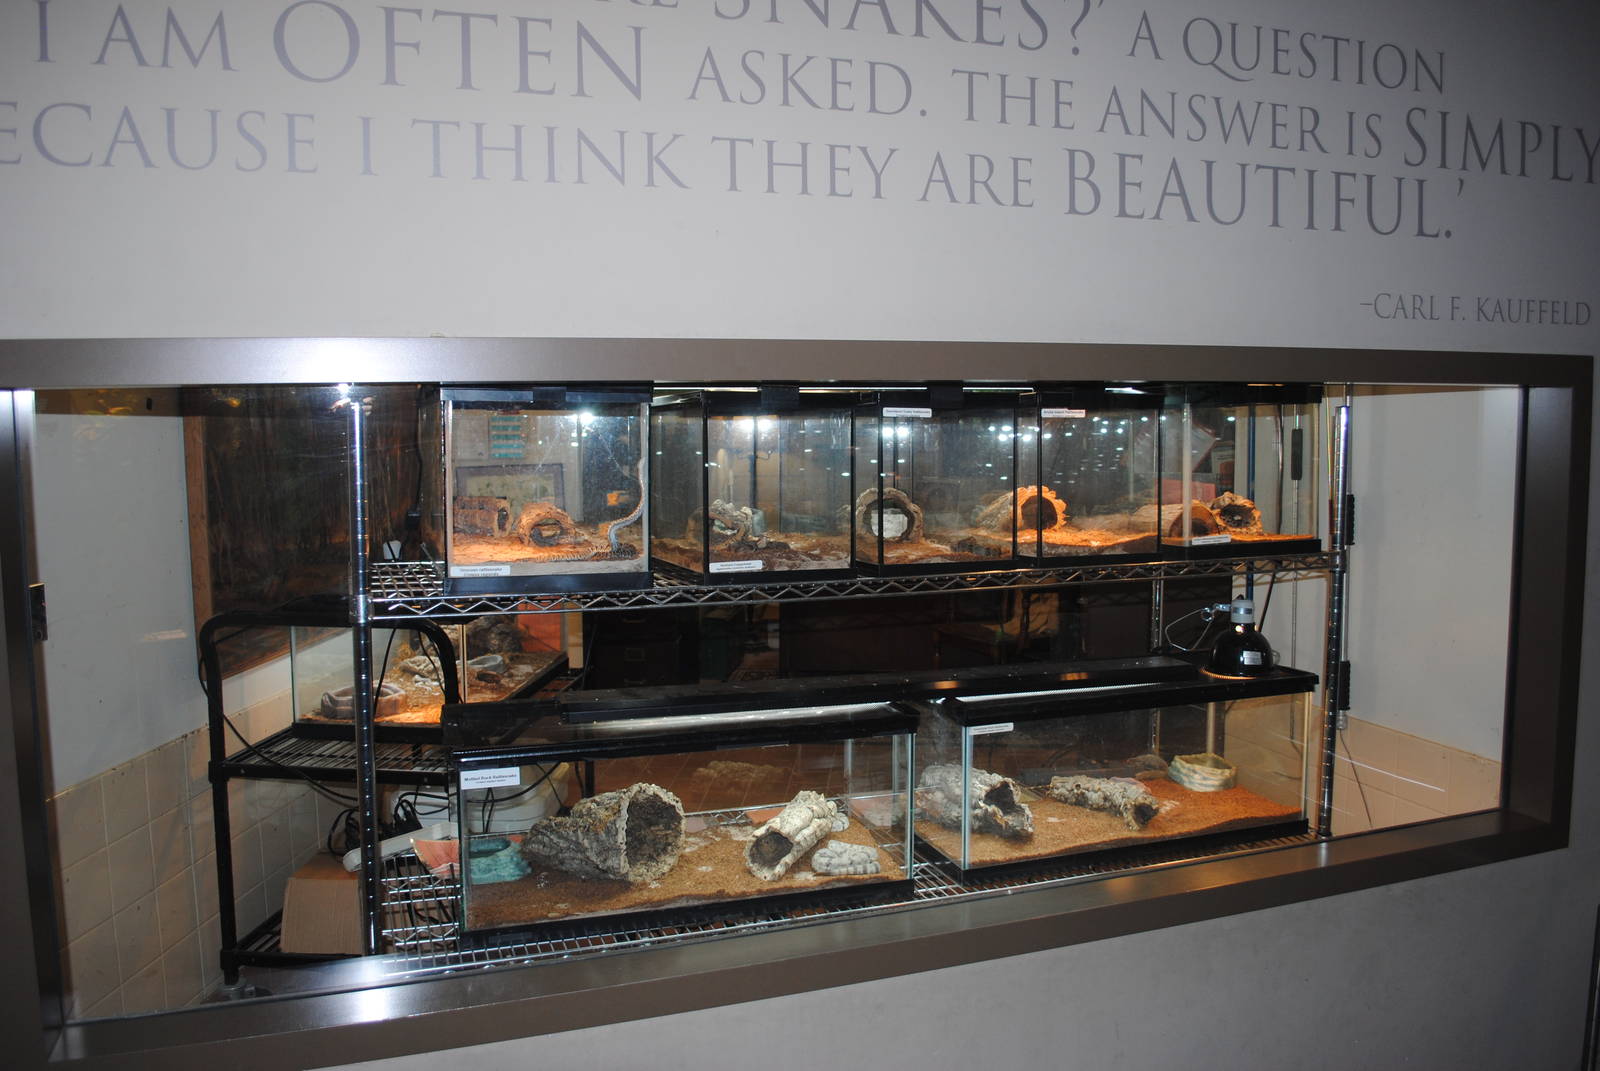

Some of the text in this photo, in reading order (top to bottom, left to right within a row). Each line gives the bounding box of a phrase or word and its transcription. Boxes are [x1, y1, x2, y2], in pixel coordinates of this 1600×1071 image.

[33, 0, 1600, 184] I AM OFTEN ASKED. THE ANSWER IS SIMPLY
[1127, 9, 1165, 61] A
[1182, 17, 1446, 95] QUESTION
[357, 115, 379, 177] I
[411, 118, 692, 189] THINK
[711, 136, 900, 200] THEY
[918, 151, 1035, 208] ARE
[1450, 296, 1467, 321] F.
[1476, 296, 1592, 326] KAUFFELD
